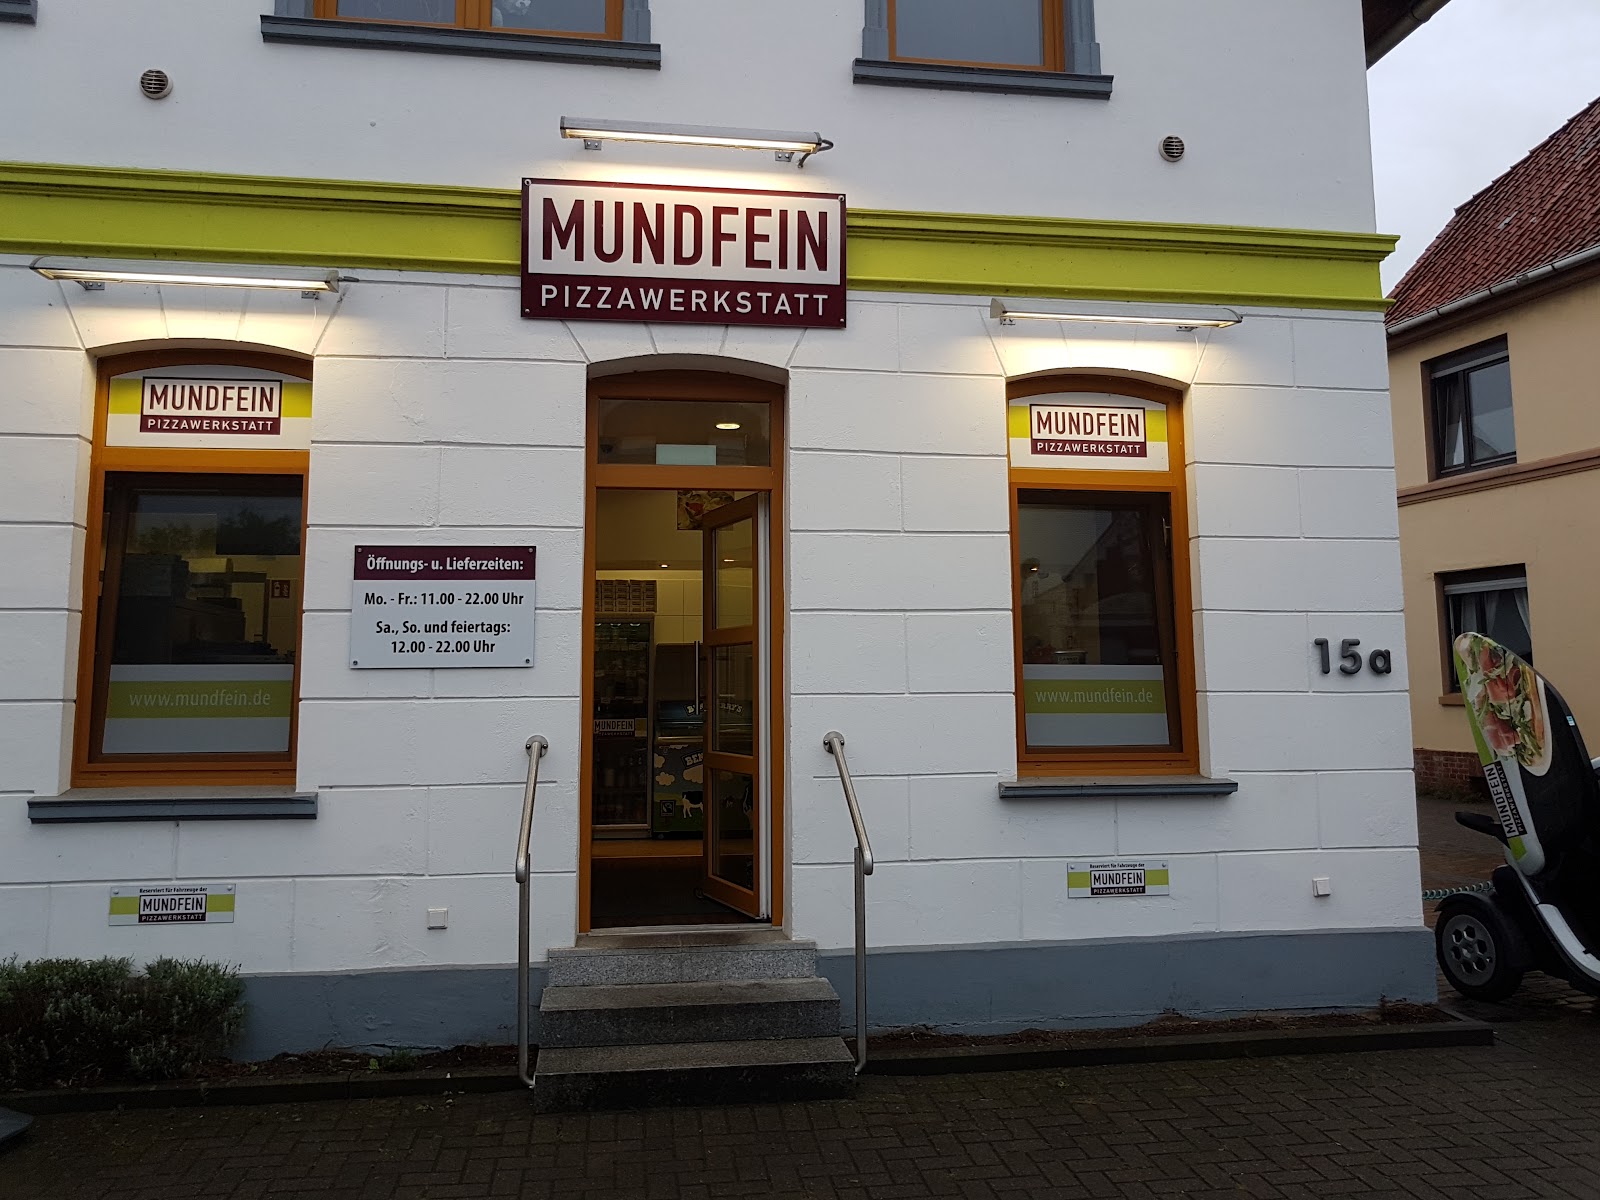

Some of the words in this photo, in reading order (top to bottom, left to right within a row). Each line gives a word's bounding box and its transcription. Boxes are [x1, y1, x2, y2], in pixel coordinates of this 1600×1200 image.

[541, 197, 828, 272] MUNDFEIN
[541, 284, 829, 316] PIZZAWERKSTATT
[149, 384, 274, 412] MUNDFEIN
[147, 418, 274, 431] PIZZAWERKSTATT
[1036, 411, 1140, 437] MUNDFEIN
[1037, 442, 1141, 454] PIZZAWERKSTATT
[366, 554, 428, 573] Öffnungs-
[431, 559, 443, 570] u.
[446, 557, 524, 570] Lieferzeiten:
[364, 592, 387, 605] Mo.
[398, 592, 418, 605] Fr.:
[420, 592, 455, 605] 11.00
[465, 592, 499, 605] 22.00
[502, 592, 524, 605] Uhr
[376, 620, 399, 635] Sa.,
[402, 620, 421, 634] So.
[424, 620, 448, 633] und
[451, 620, 511, 635] feiertags:
[391, 640, 426, 653] 12.00
[436, 640, 470, 653] 22.00
[473, 640, 496, 653] Uhr
[1314, 638, 1391, 675] 15a
[129, 689, 271, 707] www.mundfein.de
[1035, 687, 1153, 703] www.mundfein.de
[594, 720, 633, 731] MUNDFEIN
[1486, 767, 1516, 834] MUNDFEIN
[1496, 765, 1524, 832] PIZZAWERKSTATT
[1093, 872, 1142, 885] MUNDFEIN
[142, 897, 203, 912] MUNDFEIN
[141, 913, 203, 921] PIZZAWERKSTATT
